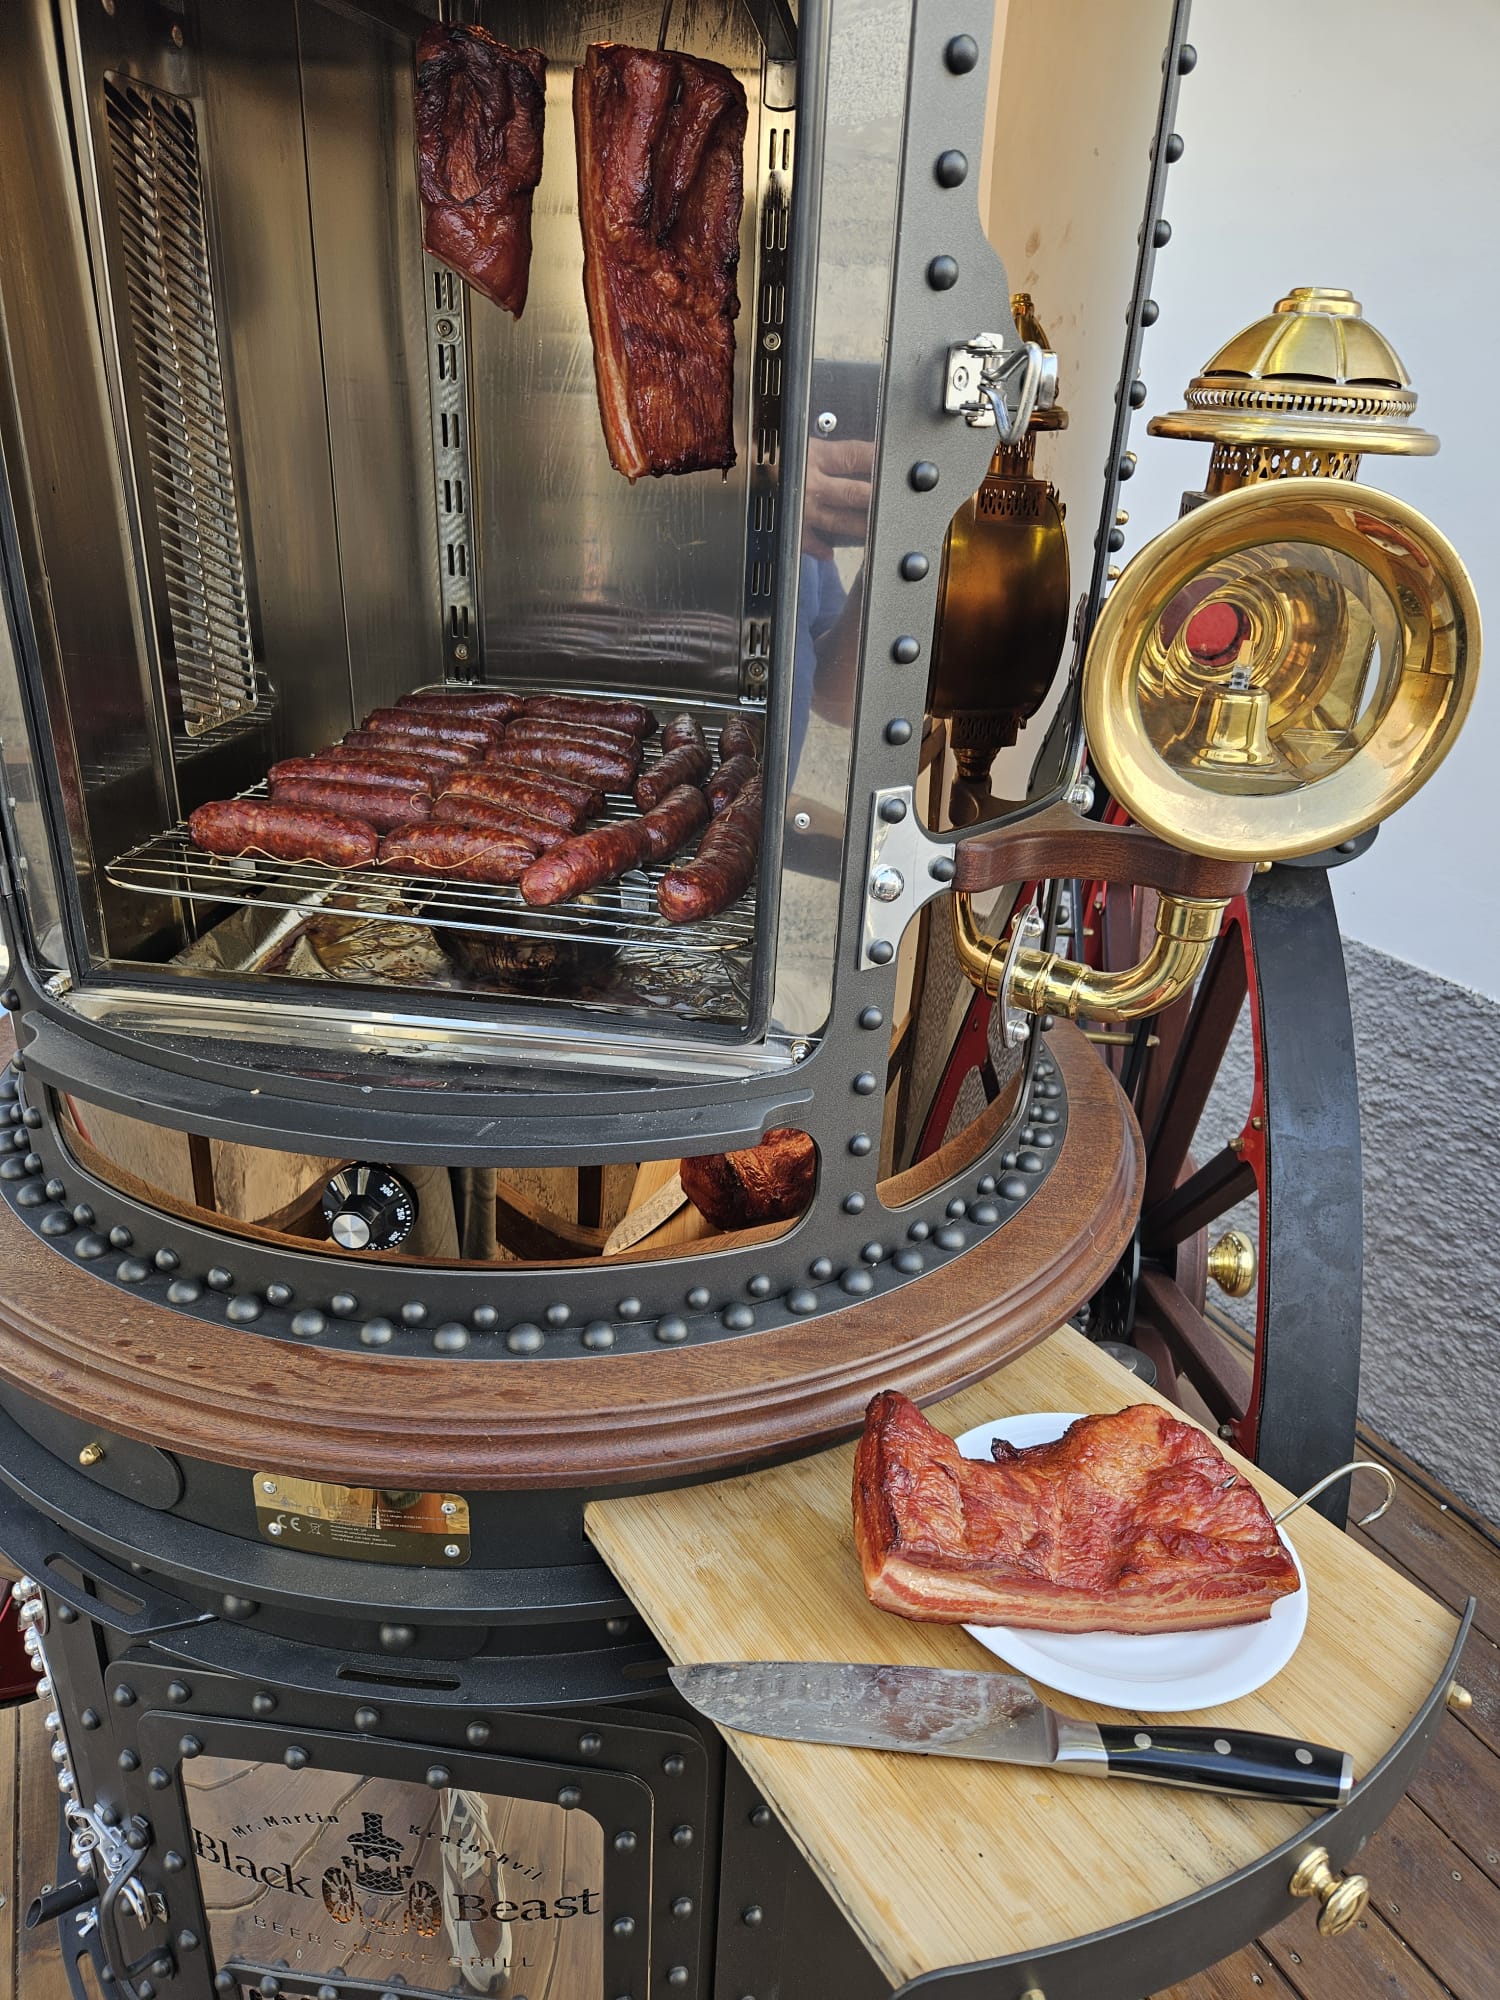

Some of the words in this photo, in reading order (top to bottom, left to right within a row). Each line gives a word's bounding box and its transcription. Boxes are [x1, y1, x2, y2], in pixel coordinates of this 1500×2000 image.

[191, 1827, 316, 1900] Black
[453, 1887, 602, 1923] Beast
[231, 1823, 262, 1839] Mr.
[264, 1811, 341, 1829] Martin
[408, 1823, 542, 1882] Kratochvil
[254, 1914, 322, 1945] BEER
[332, 1938, 434, 1965] SMOKE
[446, 1956, 536, 1969] GRILL
